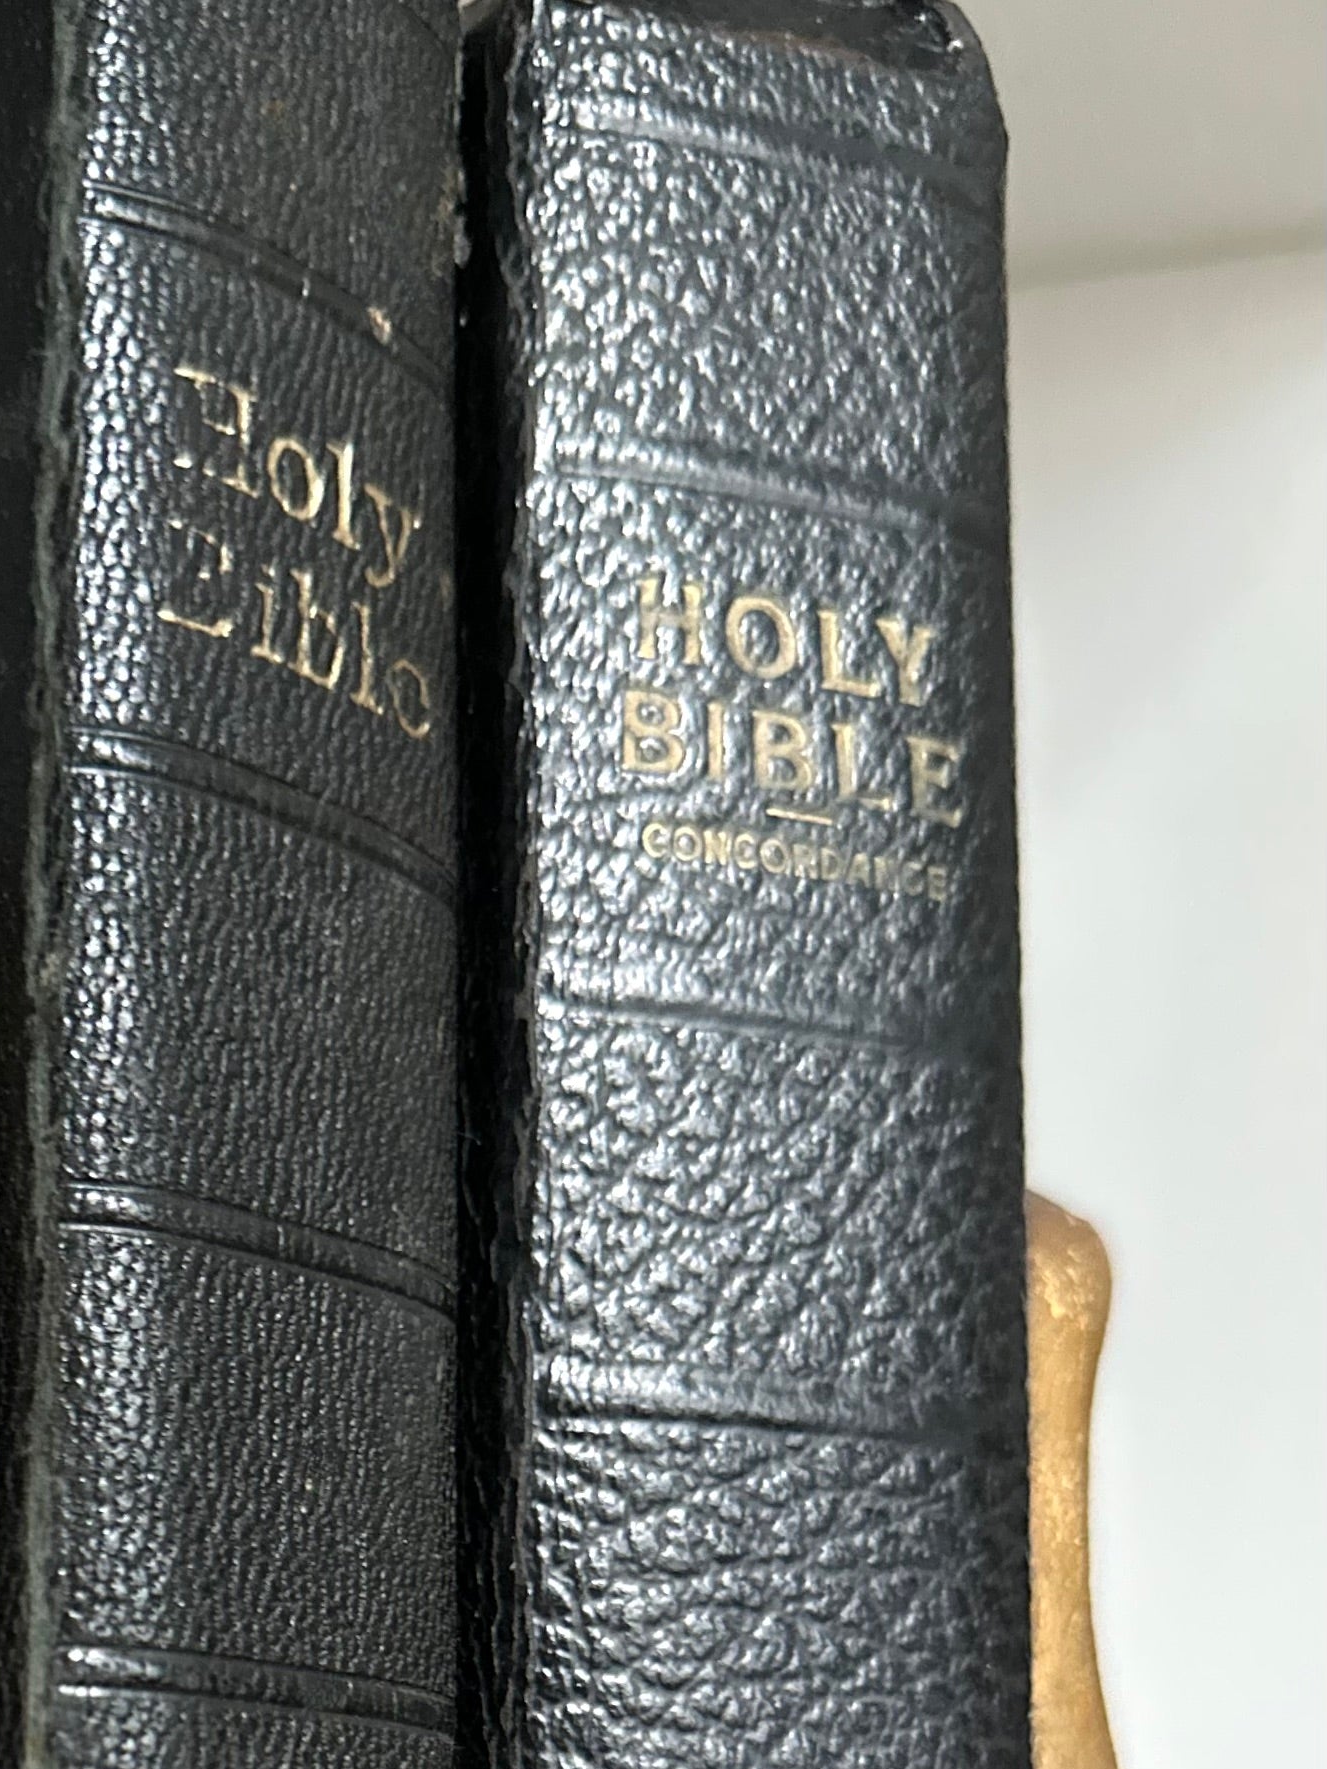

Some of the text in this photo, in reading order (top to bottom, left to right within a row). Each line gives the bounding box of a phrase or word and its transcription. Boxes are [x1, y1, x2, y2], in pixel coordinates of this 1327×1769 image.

[637, 575, 937, 707] HOLY
[621, 689, 963, 828] BIBLE
[641, 821, 952, 901] CONCORDANCE
